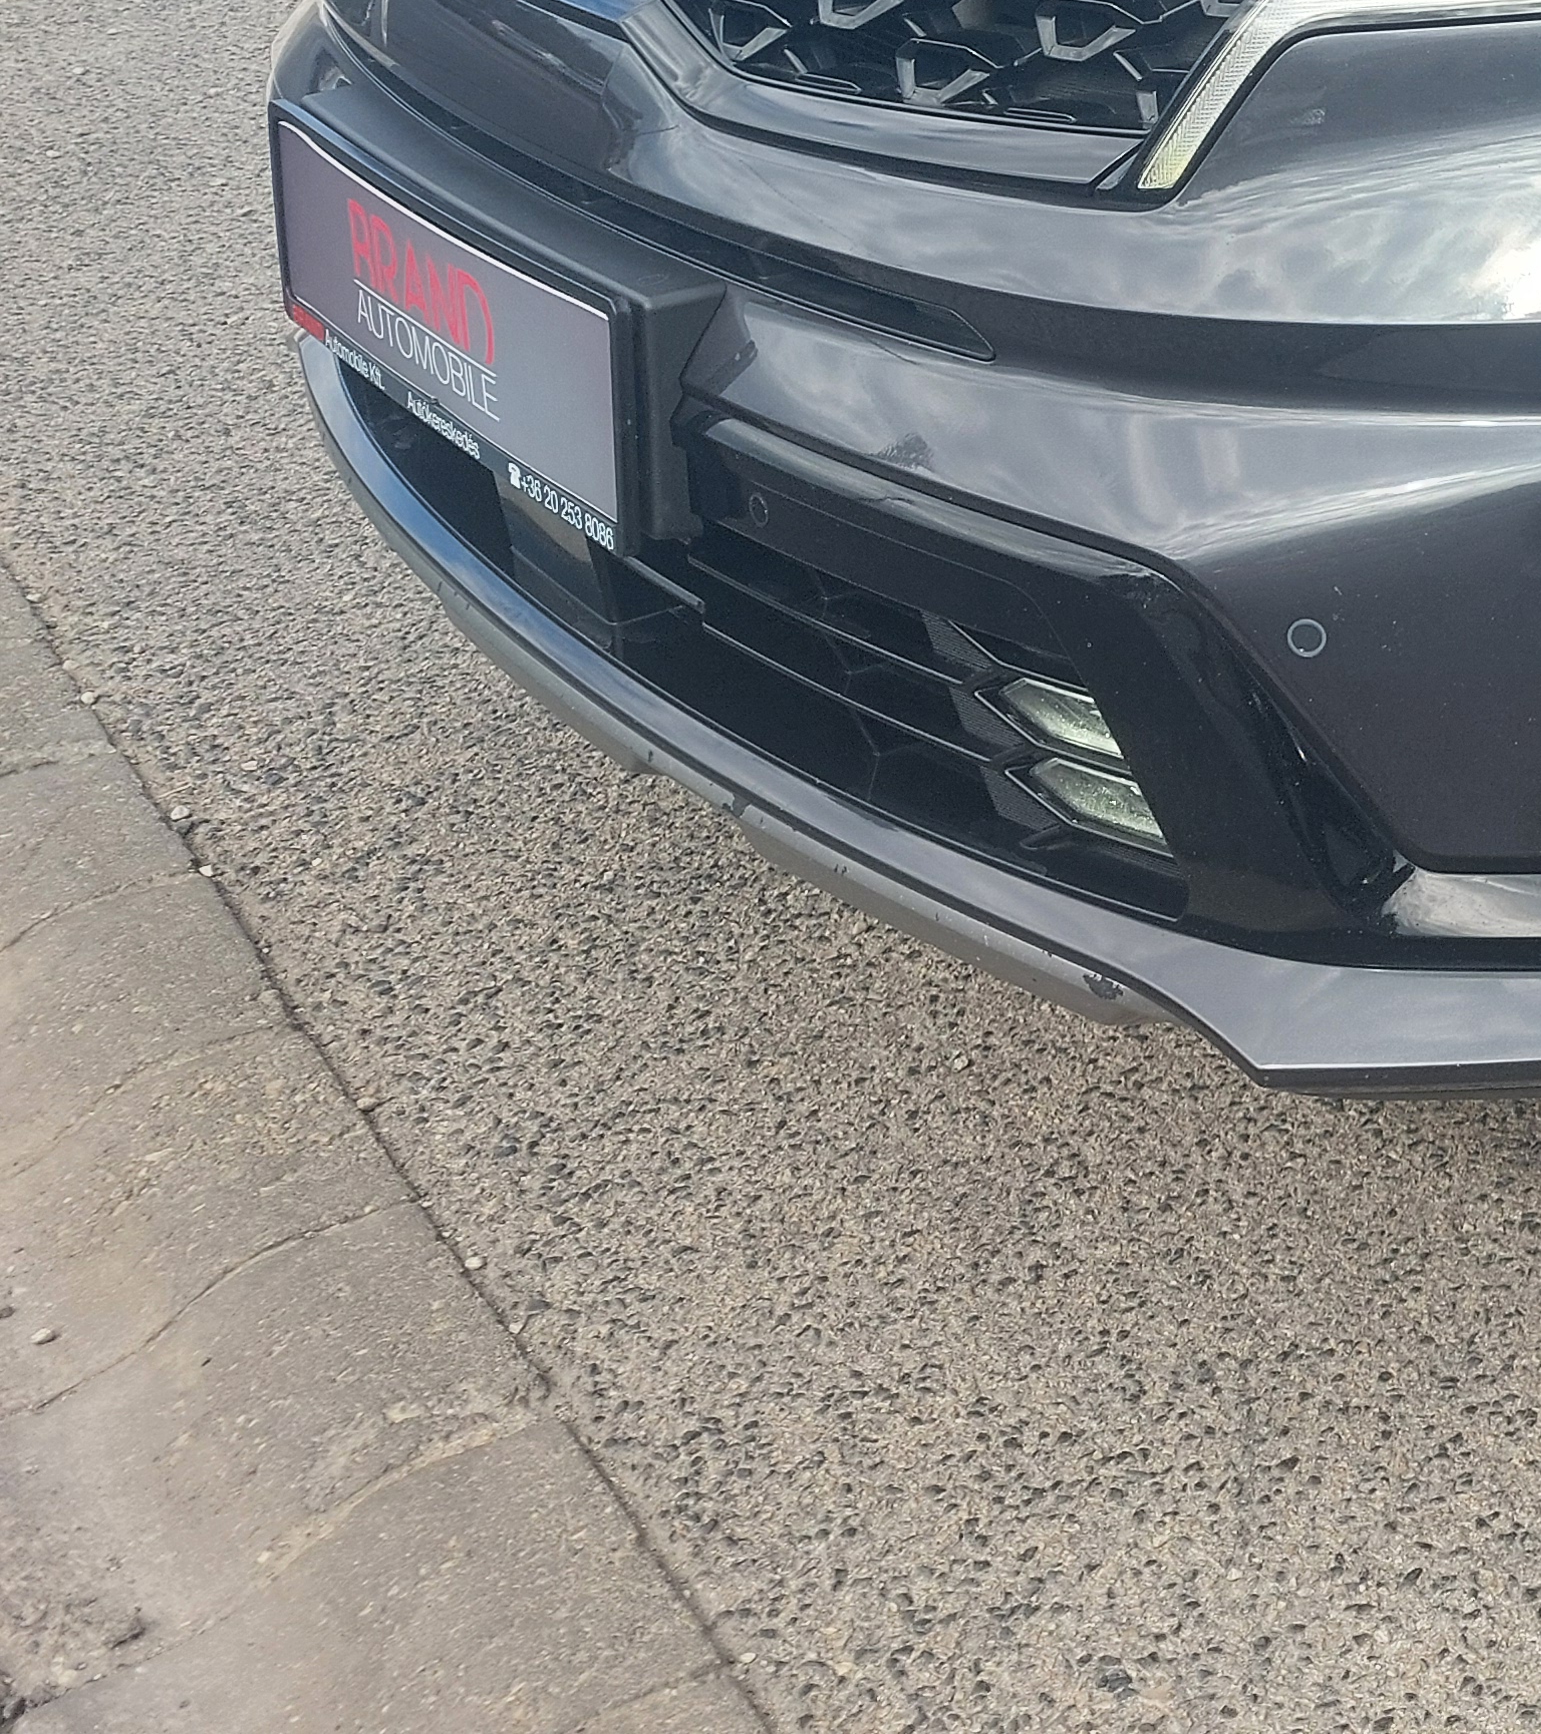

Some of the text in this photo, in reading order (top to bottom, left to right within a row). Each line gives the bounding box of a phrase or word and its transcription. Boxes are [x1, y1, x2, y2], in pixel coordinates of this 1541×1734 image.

[357, 288, 500, 423] AUTOMOBILE
[520, 474, 614, 550] +36 20 253 8086
